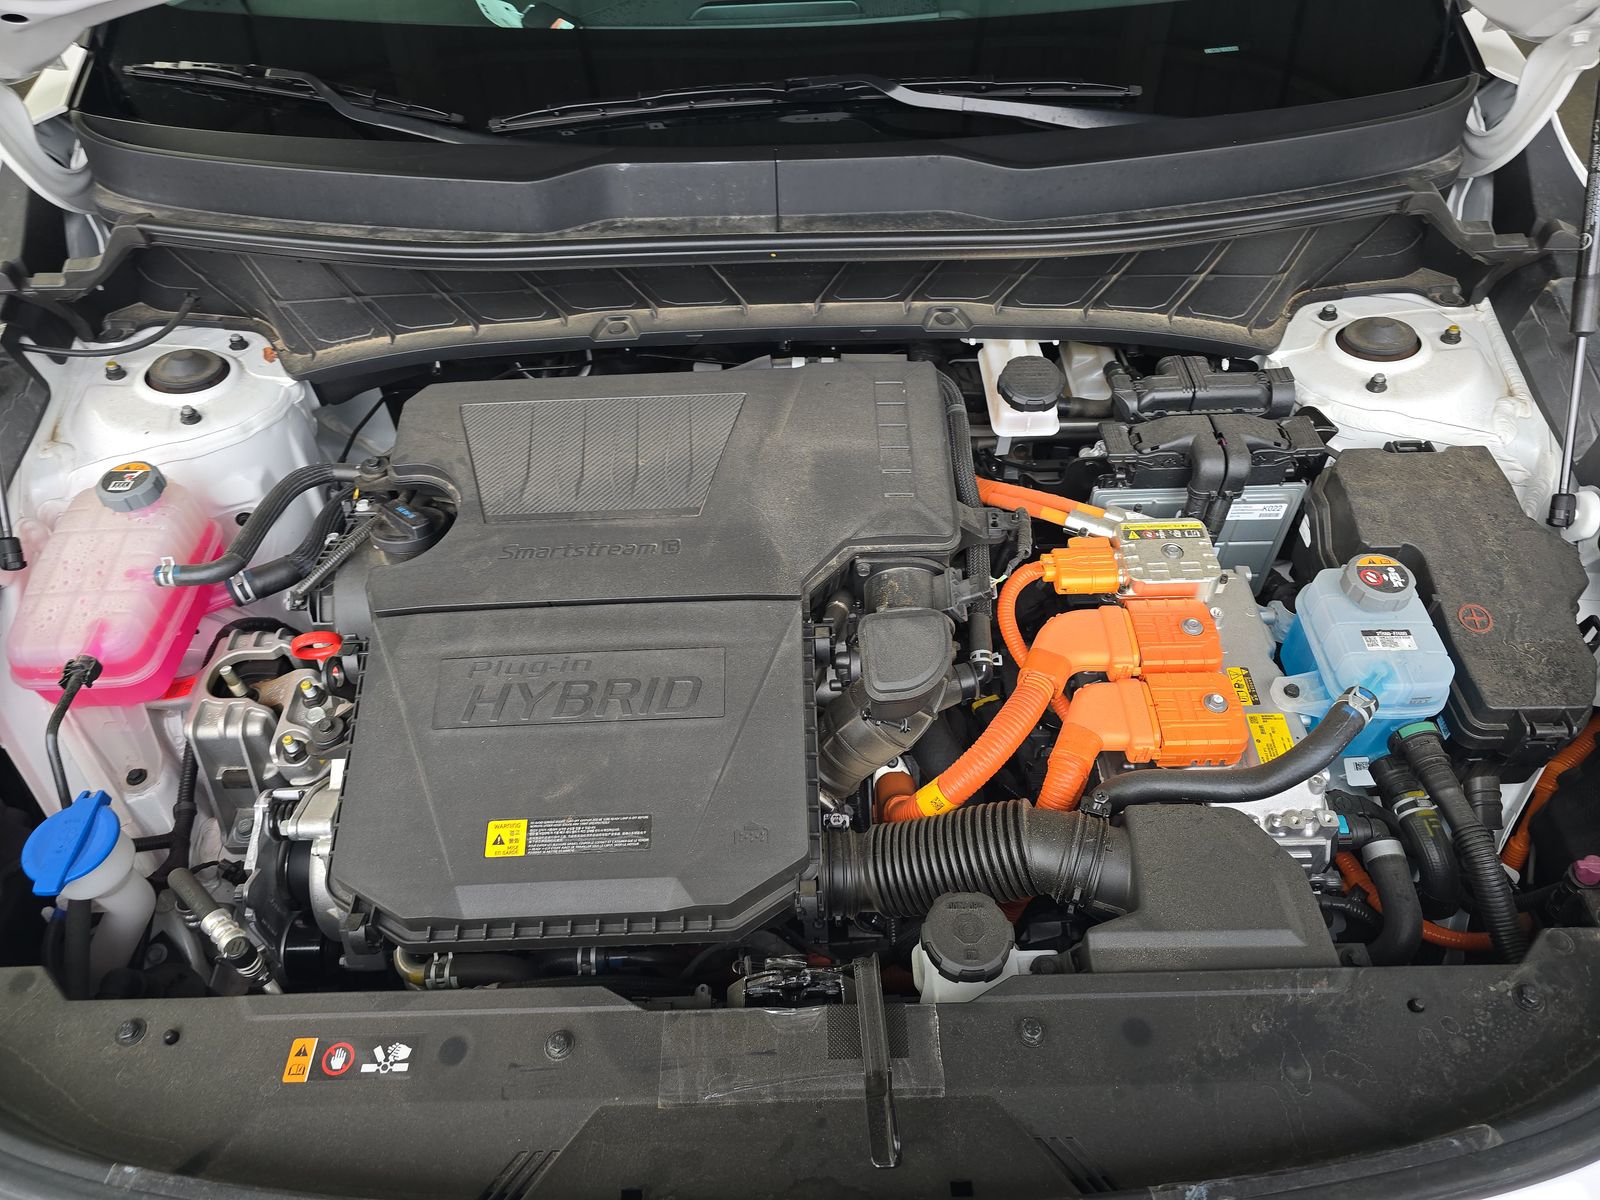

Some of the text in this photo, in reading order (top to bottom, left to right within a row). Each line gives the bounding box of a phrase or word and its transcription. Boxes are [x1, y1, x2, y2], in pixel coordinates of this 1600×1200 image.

[498, 542, 658, 560] Smartstream
[467, 657, 592, 679] Plug-in
[461, 675, 703, 723] HYBRID
